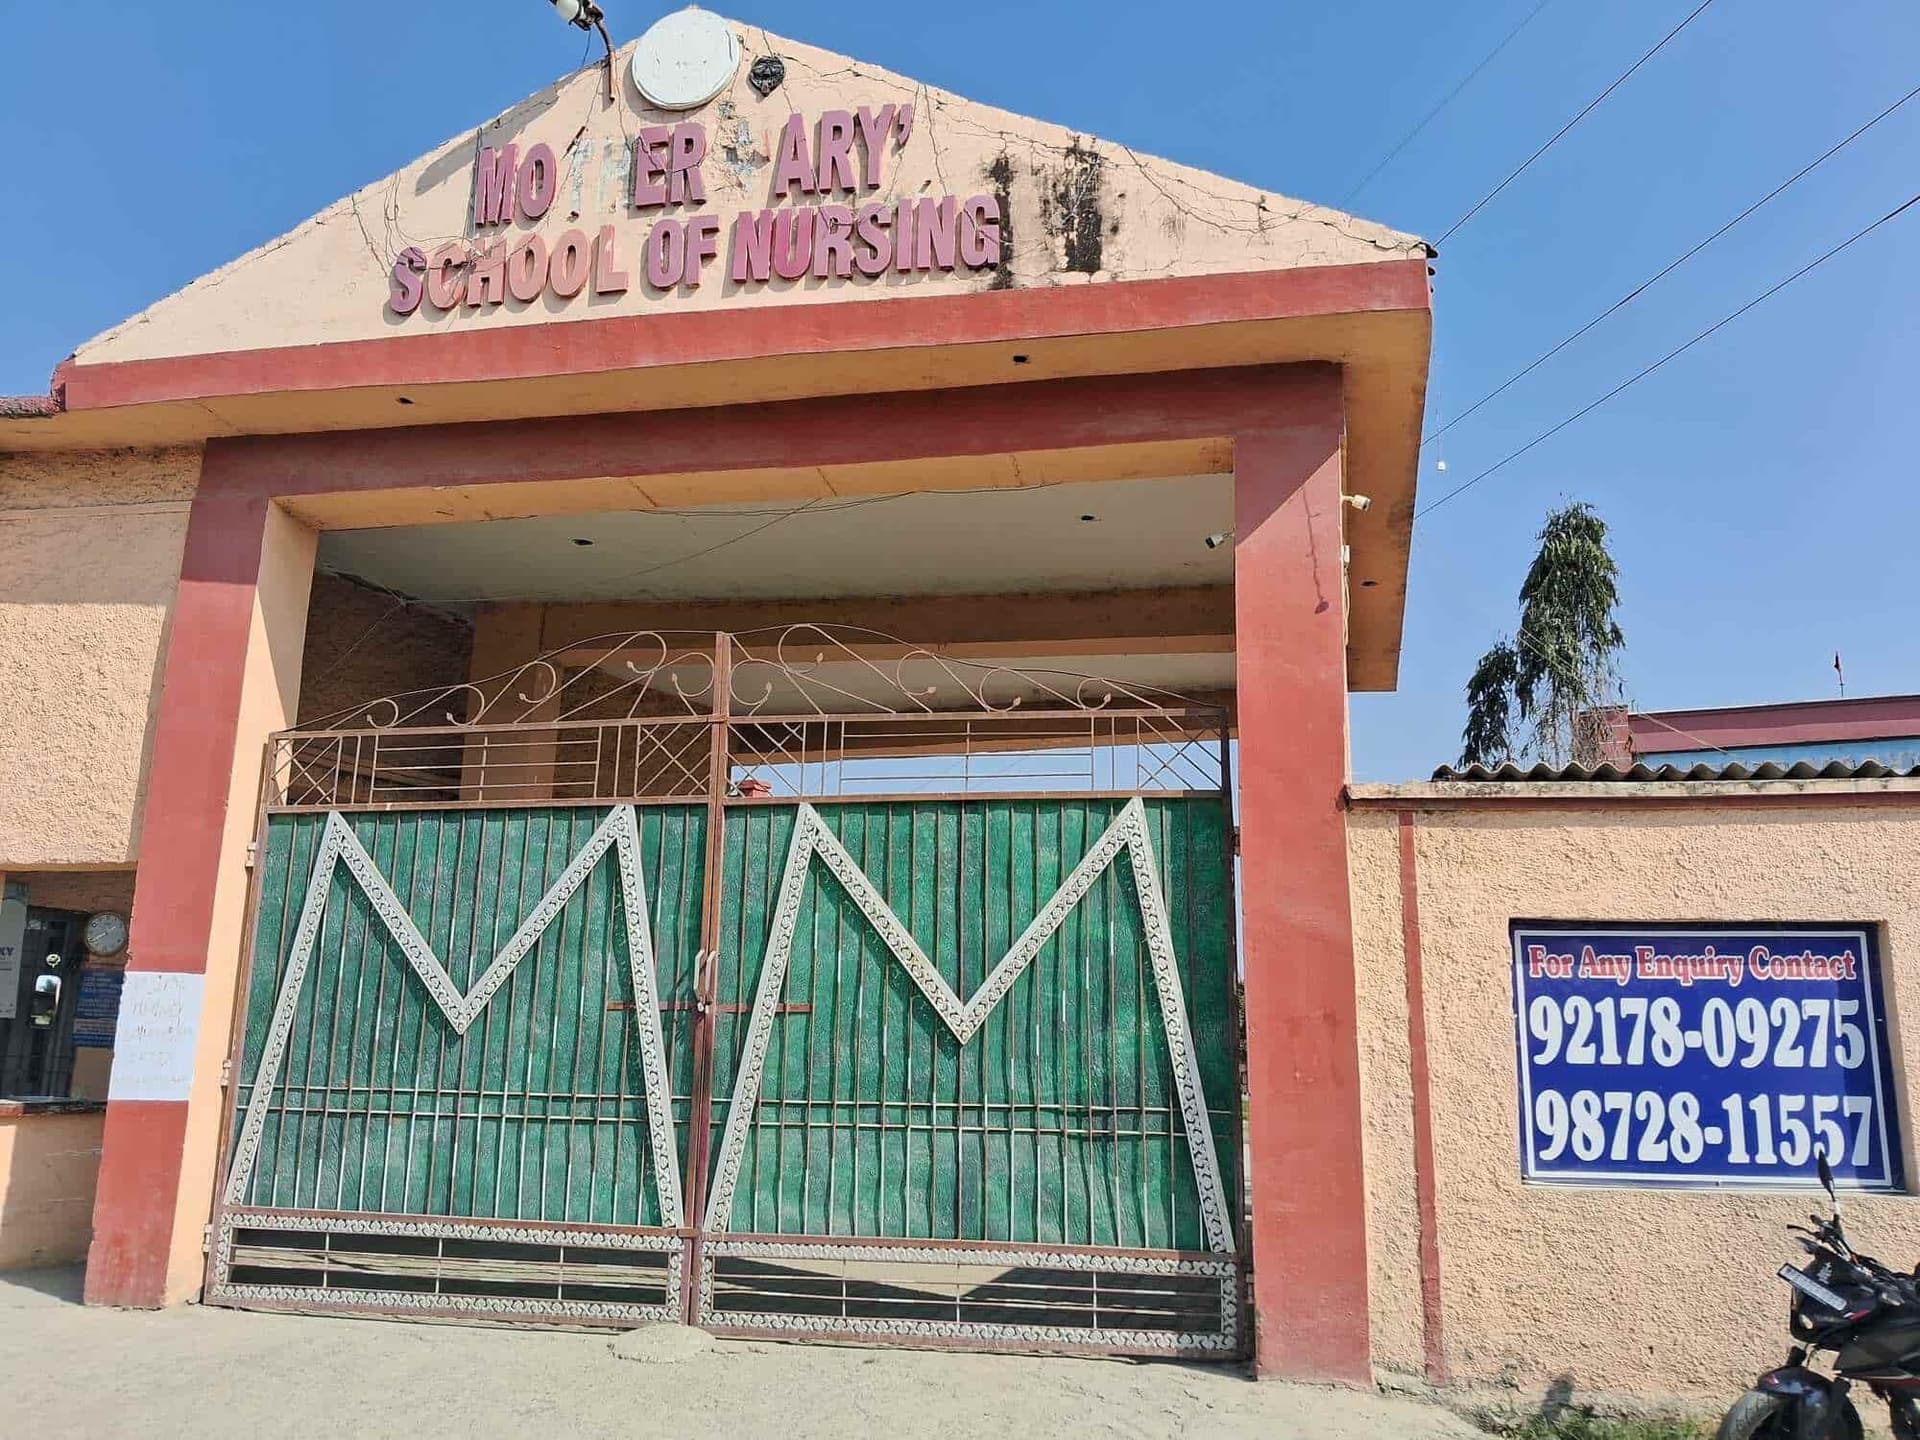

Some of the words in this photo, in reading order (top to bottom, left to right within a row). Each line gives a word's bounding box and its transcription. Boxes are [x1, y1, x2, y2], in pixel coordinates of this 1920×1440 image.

[391, 224, 629, 315] SCHOOL
[648, 215, 720, 289] OF
[732, 194, 1001, 283] NURSING
[1528, 945, 1573, 978] For
[1579, 945, 1632, 985] Any
[1636, 946, 1744, 986] Enquiry
[1749, 945, 1857, 980] Contact
[1529, 995, 1865, 1069] 92178-09275
[1535, 1090, 1872, 1167] 98728-11557
